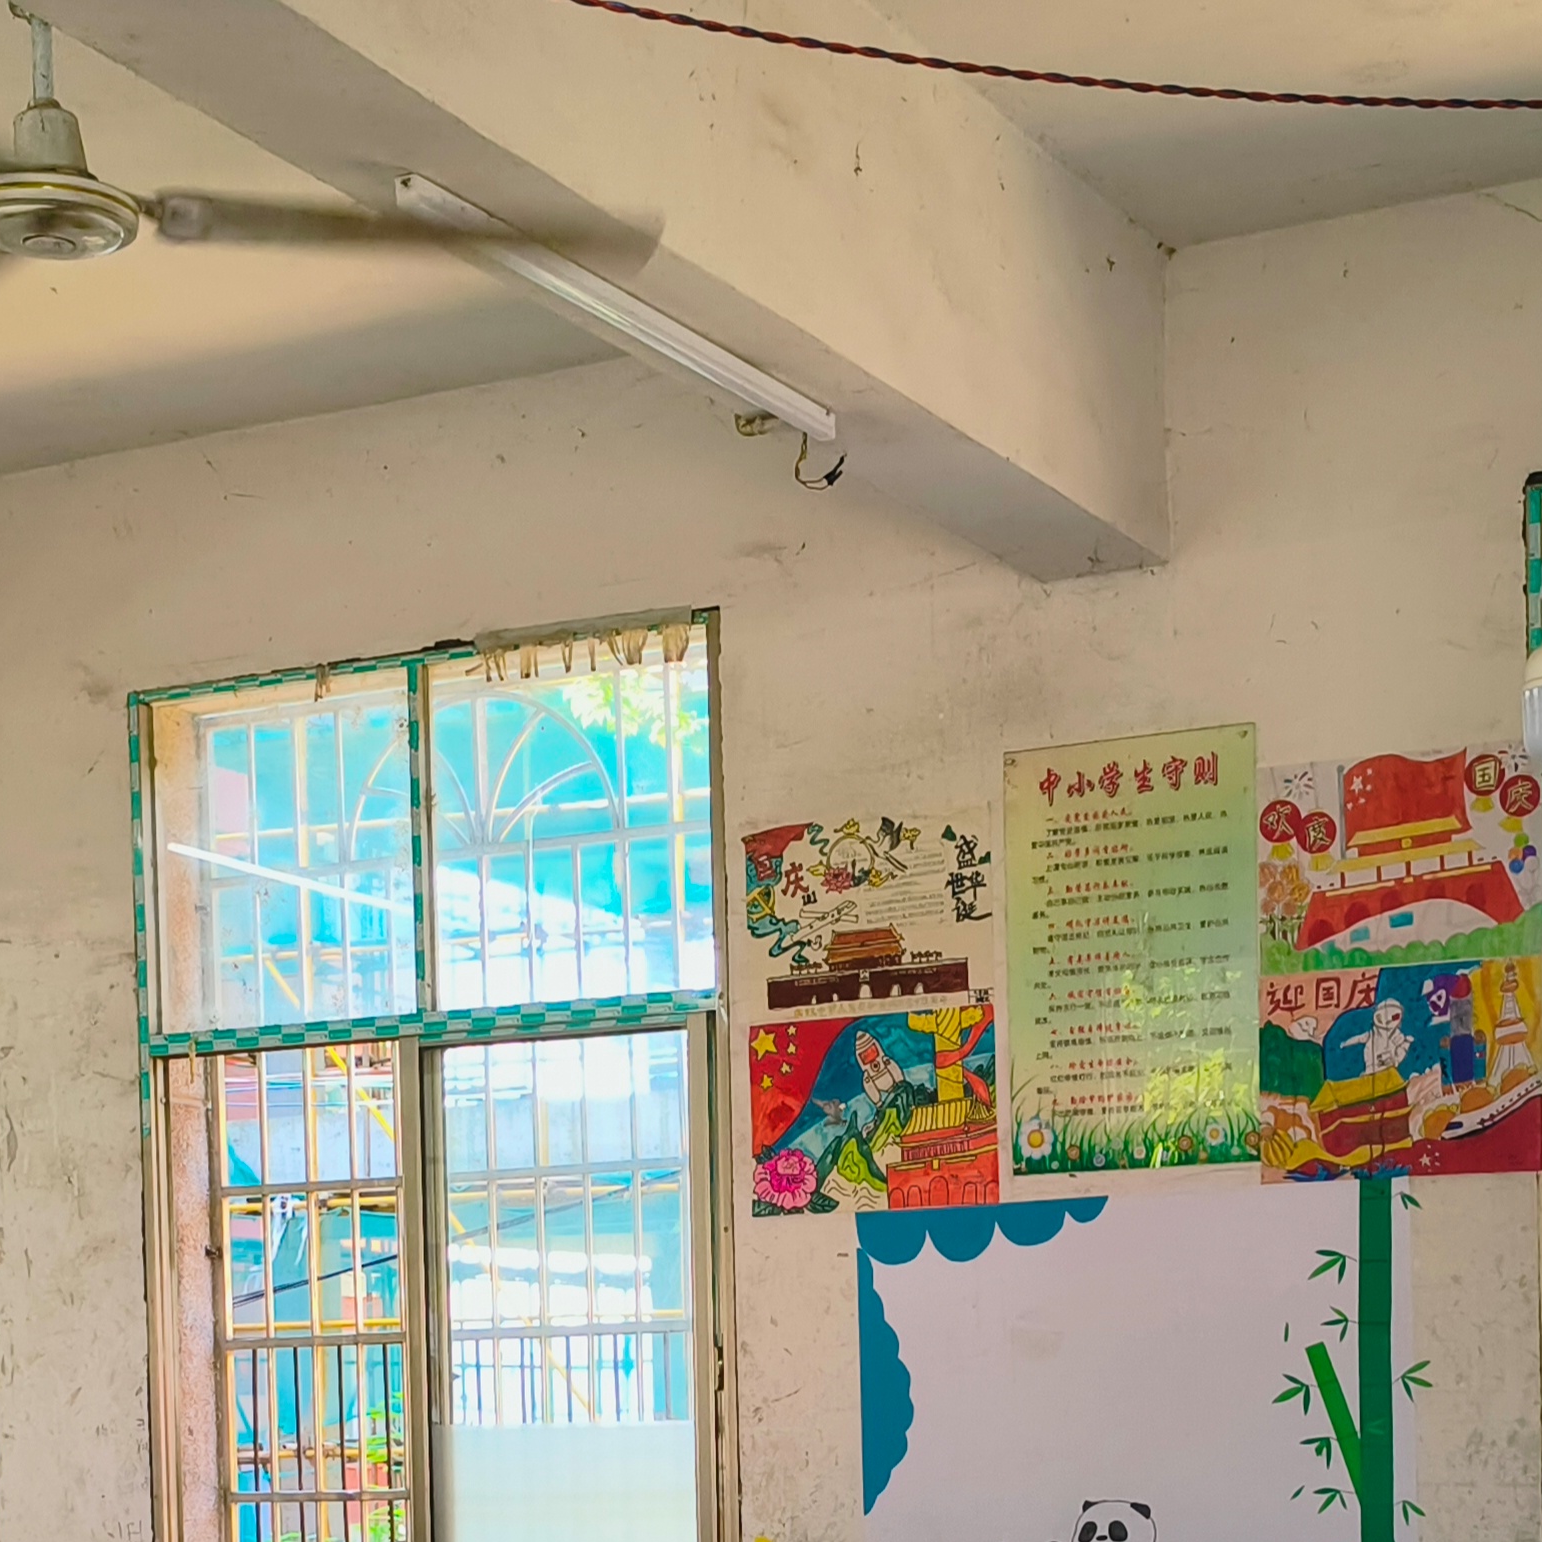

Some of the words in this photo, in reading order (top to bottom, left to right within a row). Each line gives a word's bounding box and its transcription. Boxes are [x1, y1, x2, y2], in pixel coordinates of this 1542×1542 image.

[1039, 752, 1219, 807] 中小学生守则
[1266, 970, 1378, 1016] 迎国庆
